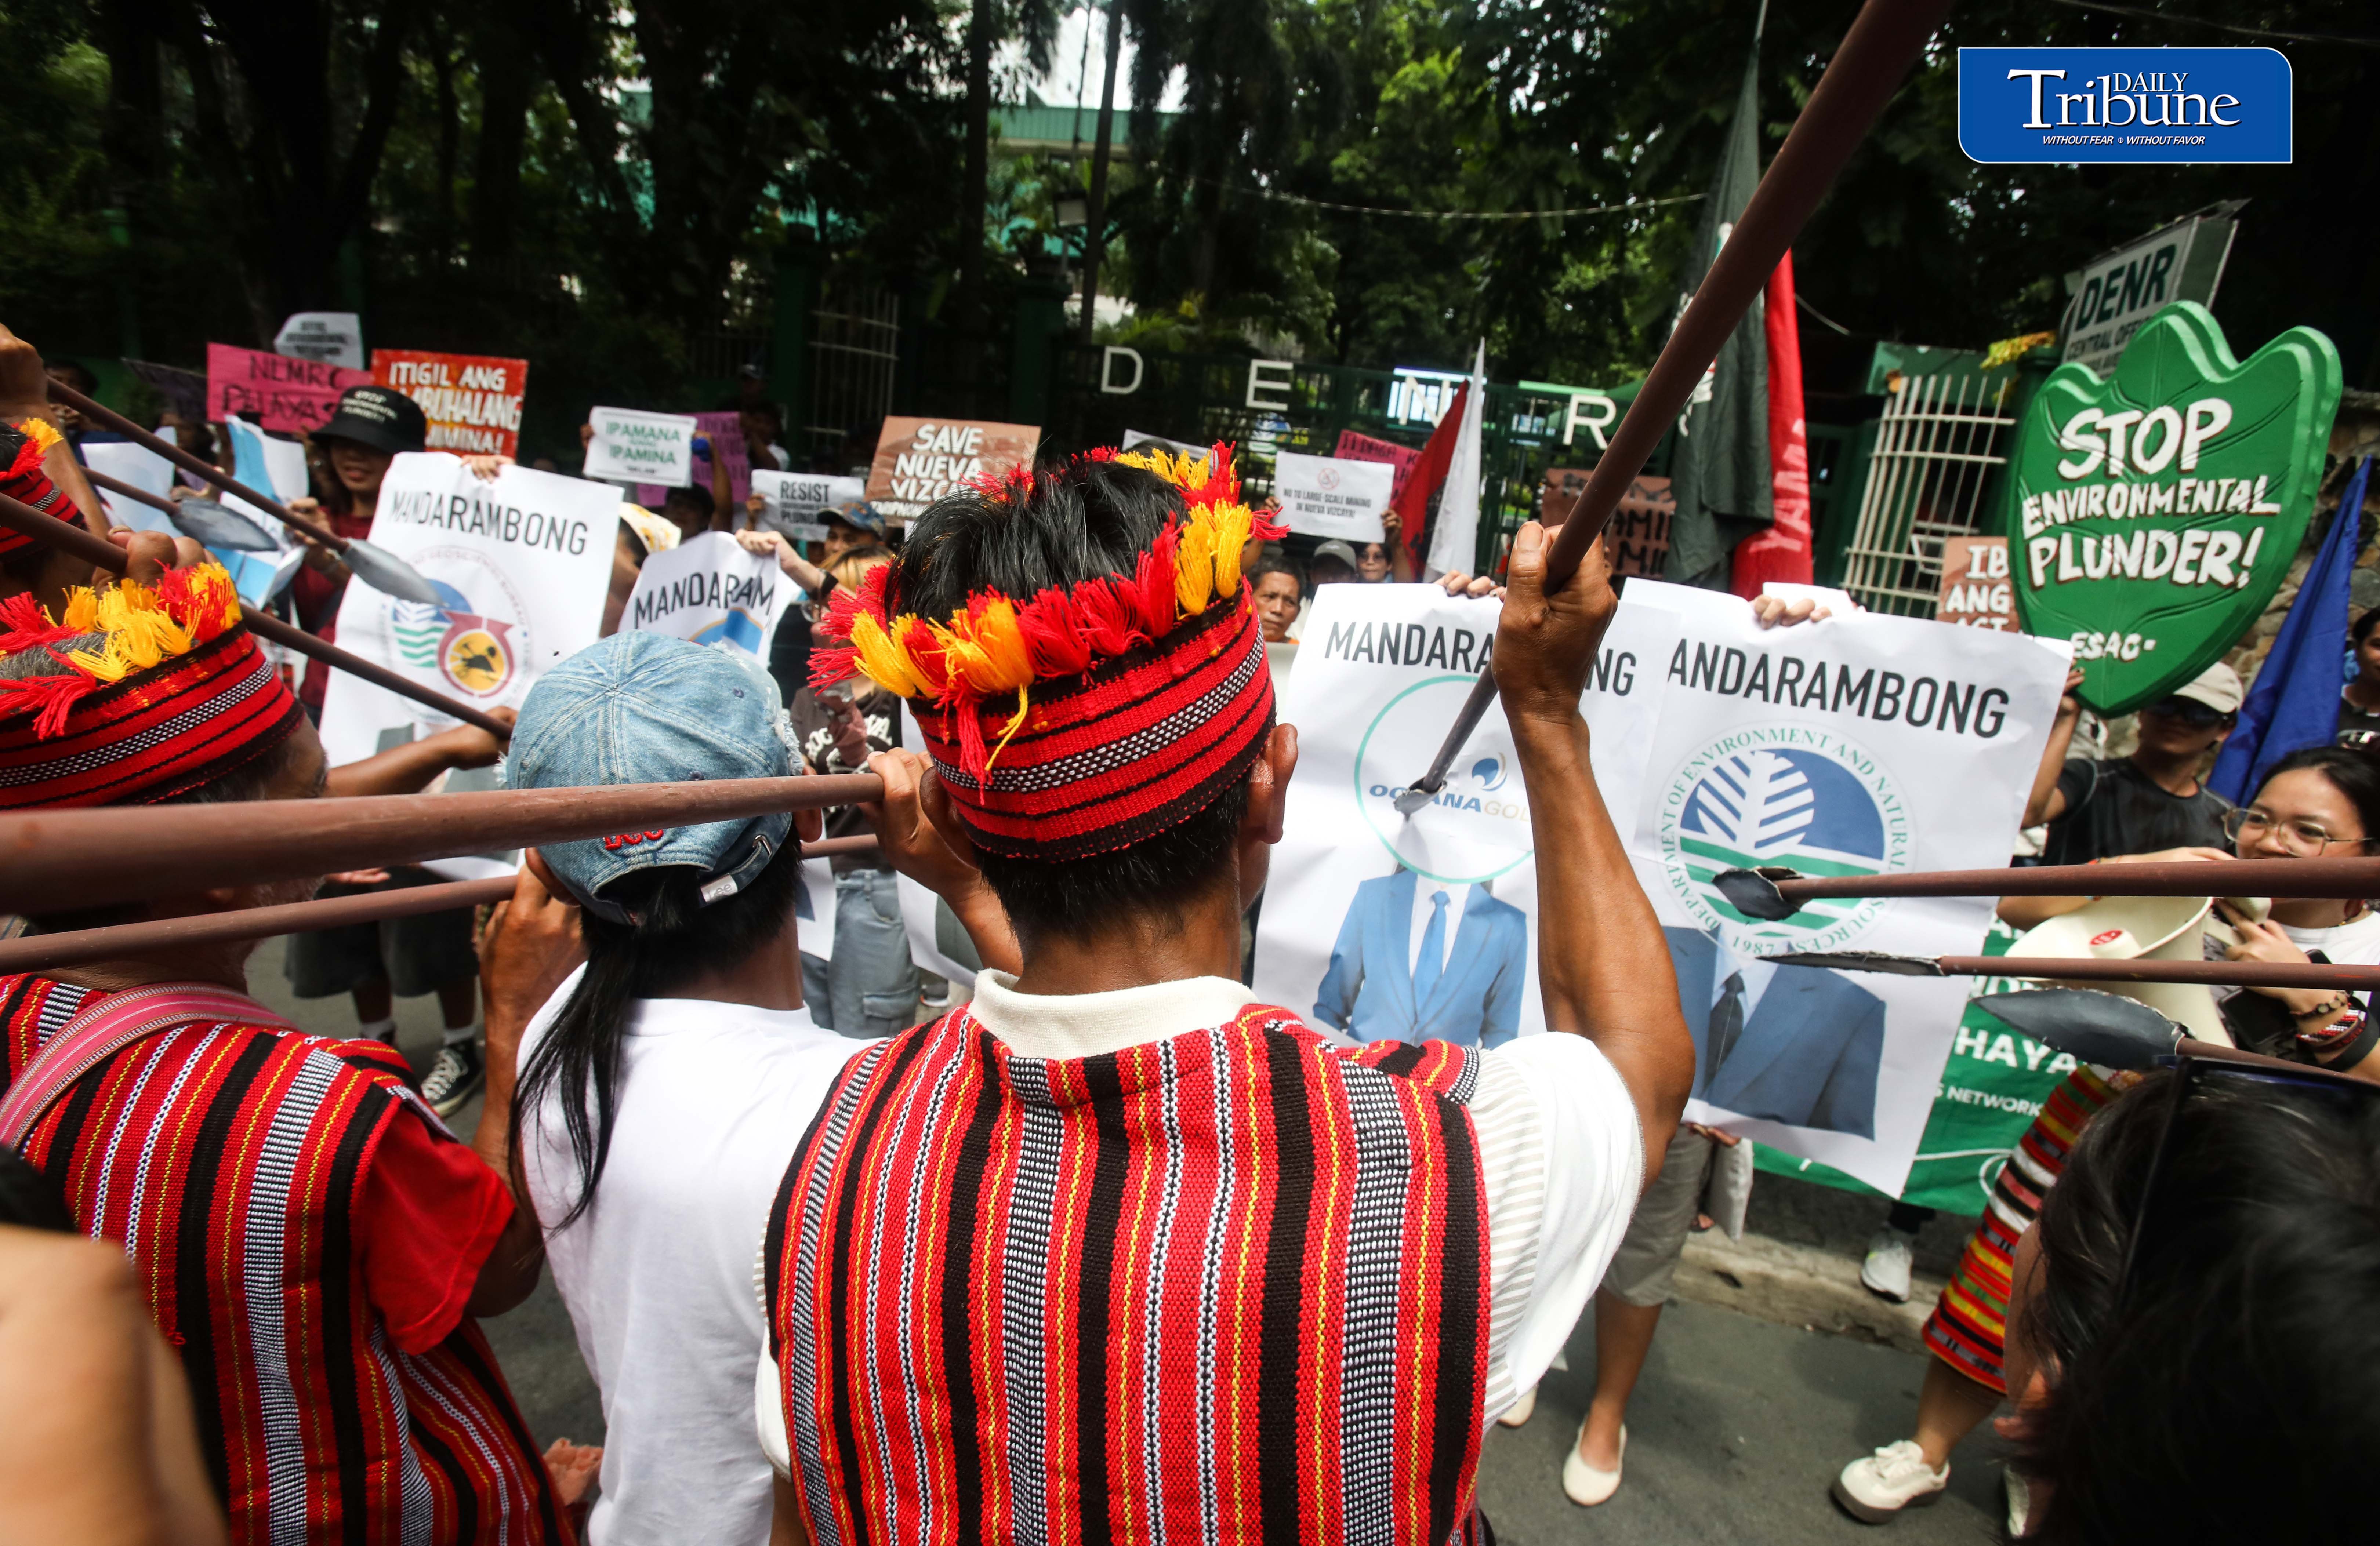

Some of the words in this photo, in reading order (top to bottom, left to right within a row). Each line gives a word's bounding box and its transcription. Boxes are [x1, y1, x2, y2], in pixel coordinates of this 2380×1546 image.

[2075, 243, 2177, 331] DENR
[388, 361, 451, 387] ITIGIL
[458, 364, 507, 392] ANG
[606, 422, 681, 443] IPAMANA
[912, 423, 984, 455] SAVE
[2058, 397, 2232, 480] STOP
[609, 443, 676, 464] IPAMINA
[894, 453, 984, 484] NUEVA
[780, 481, 830, 503] RESIST
[1284, 488, 1293, 497] NO
[1294, 490, 1302, 499] TO
[1296, 502, 1303, 511] IN
[1304, 503, 1325, 514] NUEVA
[2022, 475, 2282, 541] ENVIRONMENTAL
[2029, 526, 2264, 589] PLUNDER!
[1945, 583, 2010, 615] ANG
[1668, 638, 2009, 739] ANDARAMBONG
[1682, 728, 1832, 782] ENVIRONMENT
[1832, 743, 1875, 776] AND
[1668, 780, 1686, 805] OF
[1871, 776, 1908, 870] NATURAL
[1661, 808, 1719, 931] DEPARTMENT
[1796, 899, 1886, 952] SOURCES
[1733, 936, 1775, 956] 1987
[1947, 1086, 2043, 1118] NETWORK
